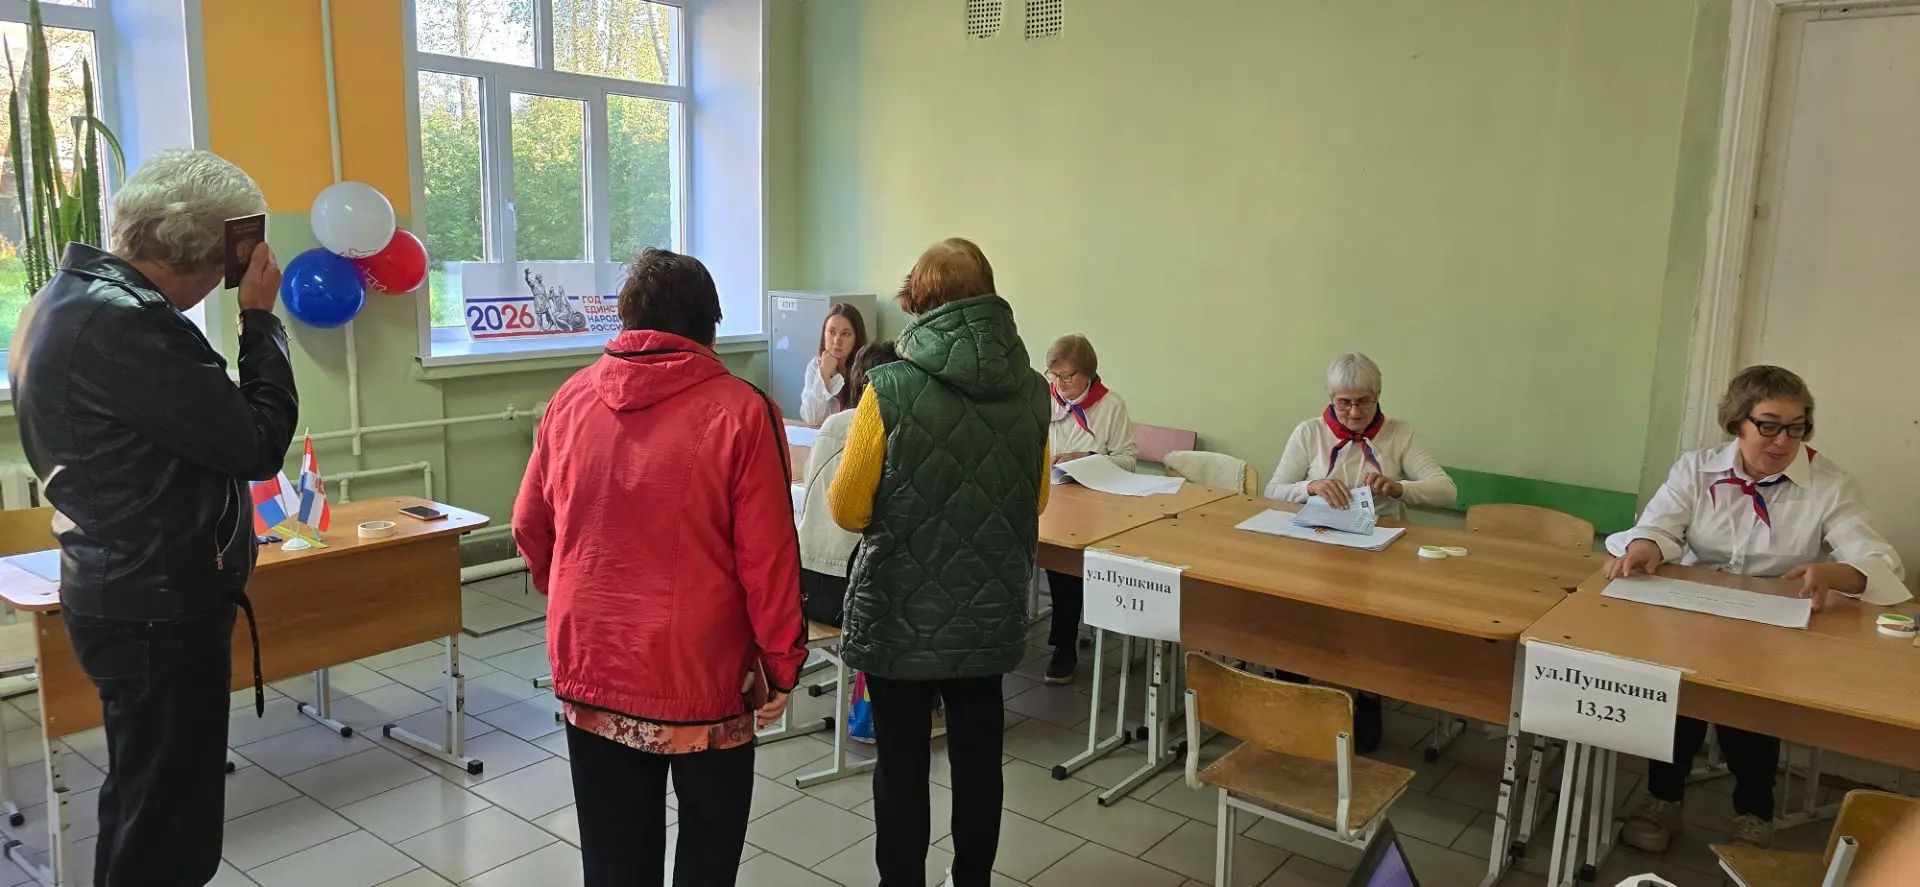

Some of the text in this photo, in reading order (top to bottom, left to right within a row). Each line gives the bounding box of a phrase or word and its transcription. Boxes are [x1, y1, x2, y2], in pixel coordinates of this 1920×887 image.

[582, 295, 601, 304] ГОД
[467, 304, 535, 331] 2026
[1086, 569, 1171, 594] ул.Пушкина
[1131, 598, 1144, 612] 11
[1534, 665, 1668, 703] ул.Пушкина
[1575, 699, 1627, 723] 13,23
